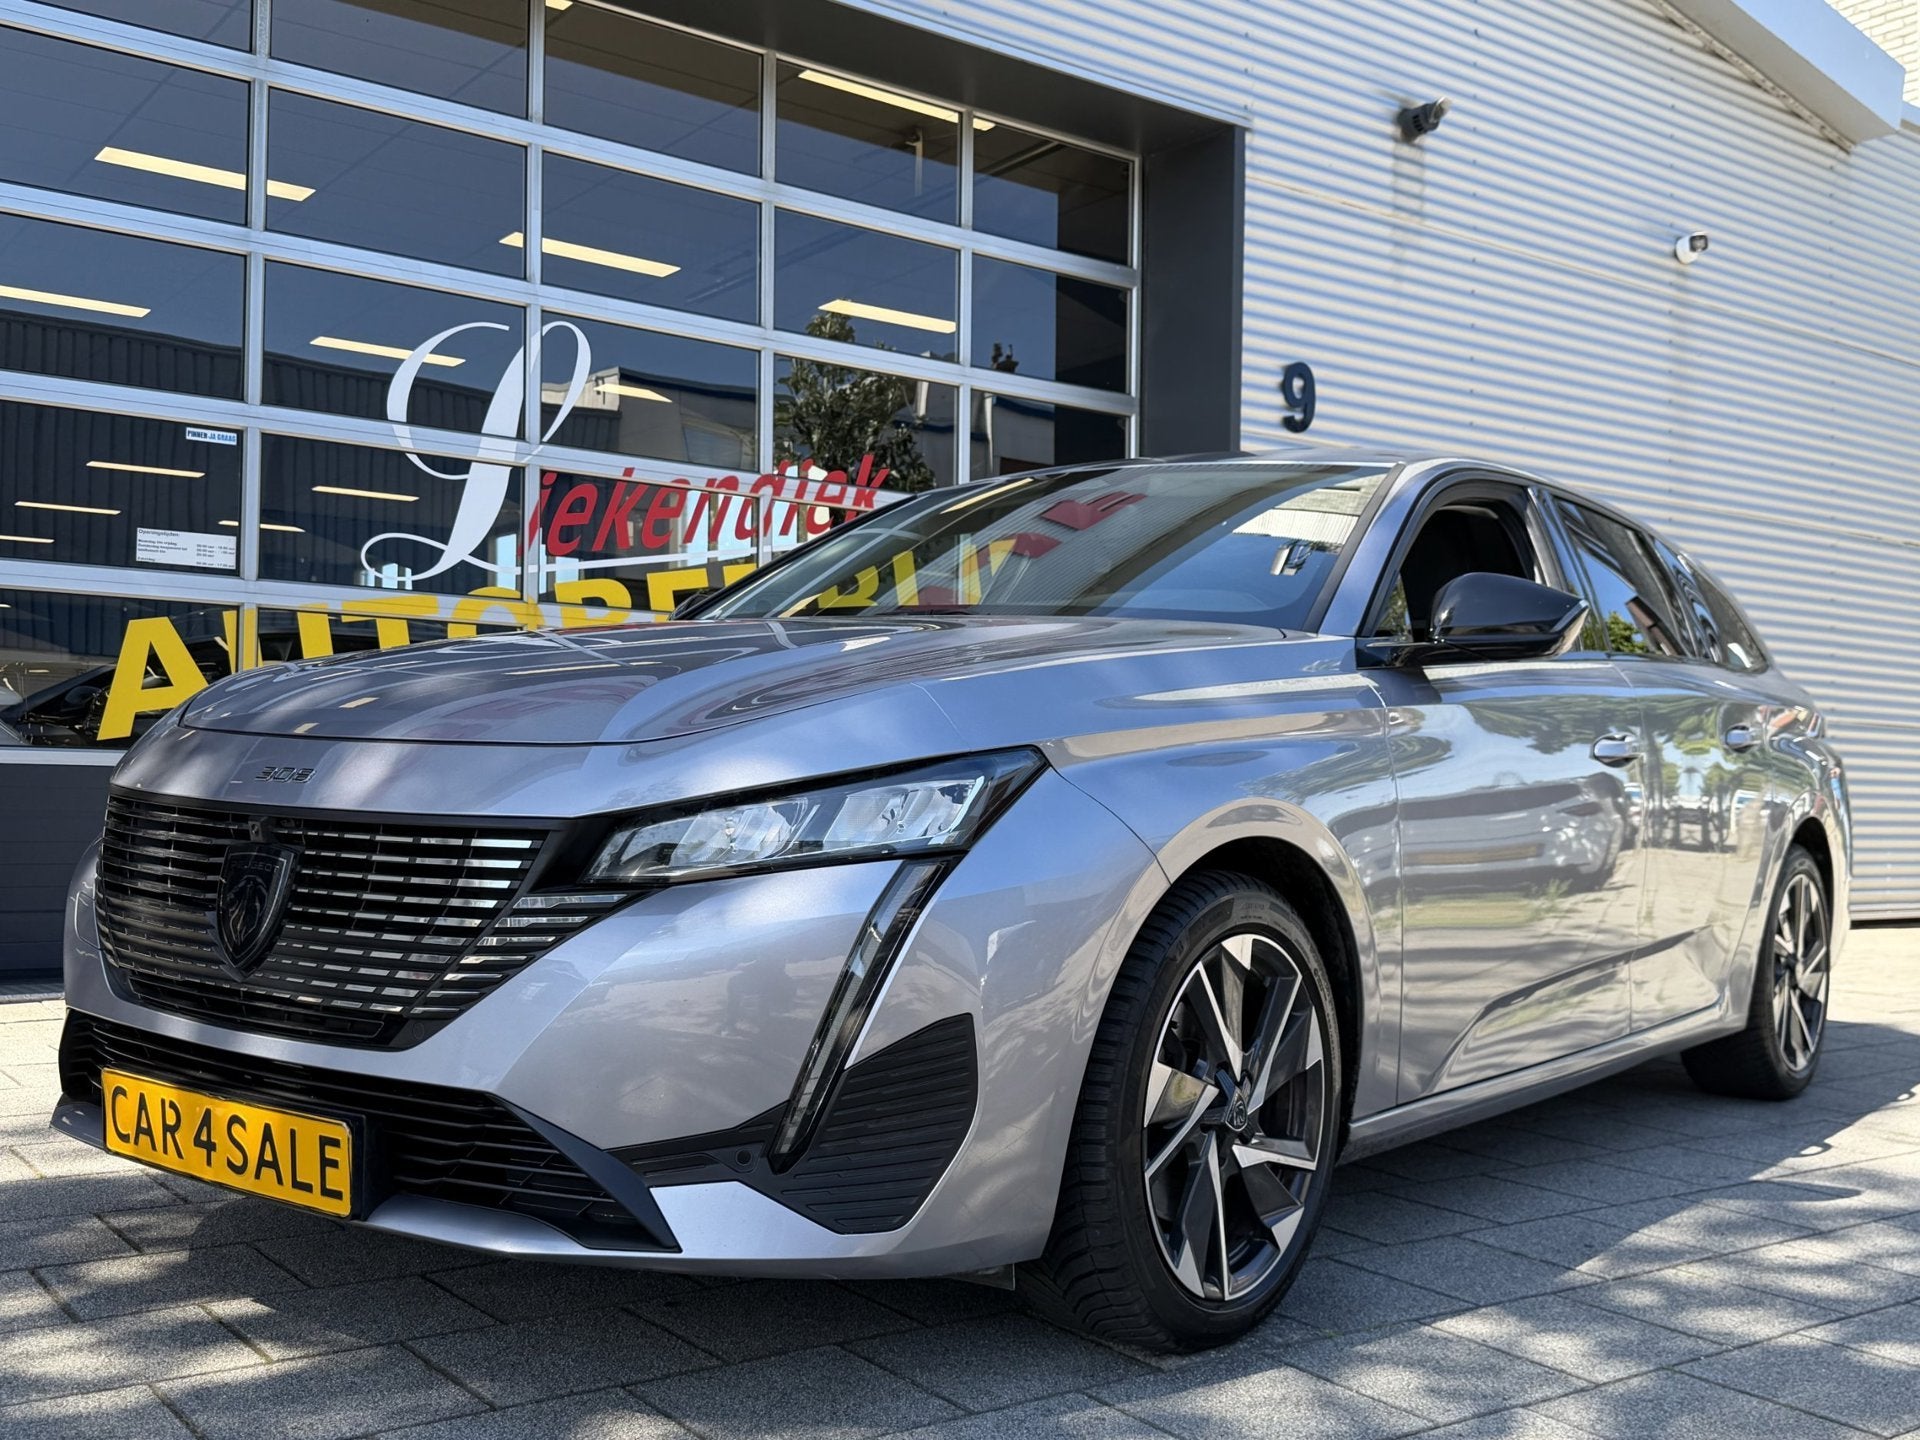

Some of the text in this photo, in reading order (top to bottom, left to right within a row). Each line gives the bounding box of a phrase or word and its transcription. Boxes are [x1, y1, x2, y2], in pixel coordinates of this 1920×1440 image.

[1283, 362, 1316, 433] 9
[255, 766, 316, 784] 308
[111, 1085, 344, 1201] CAR 4 SALE
